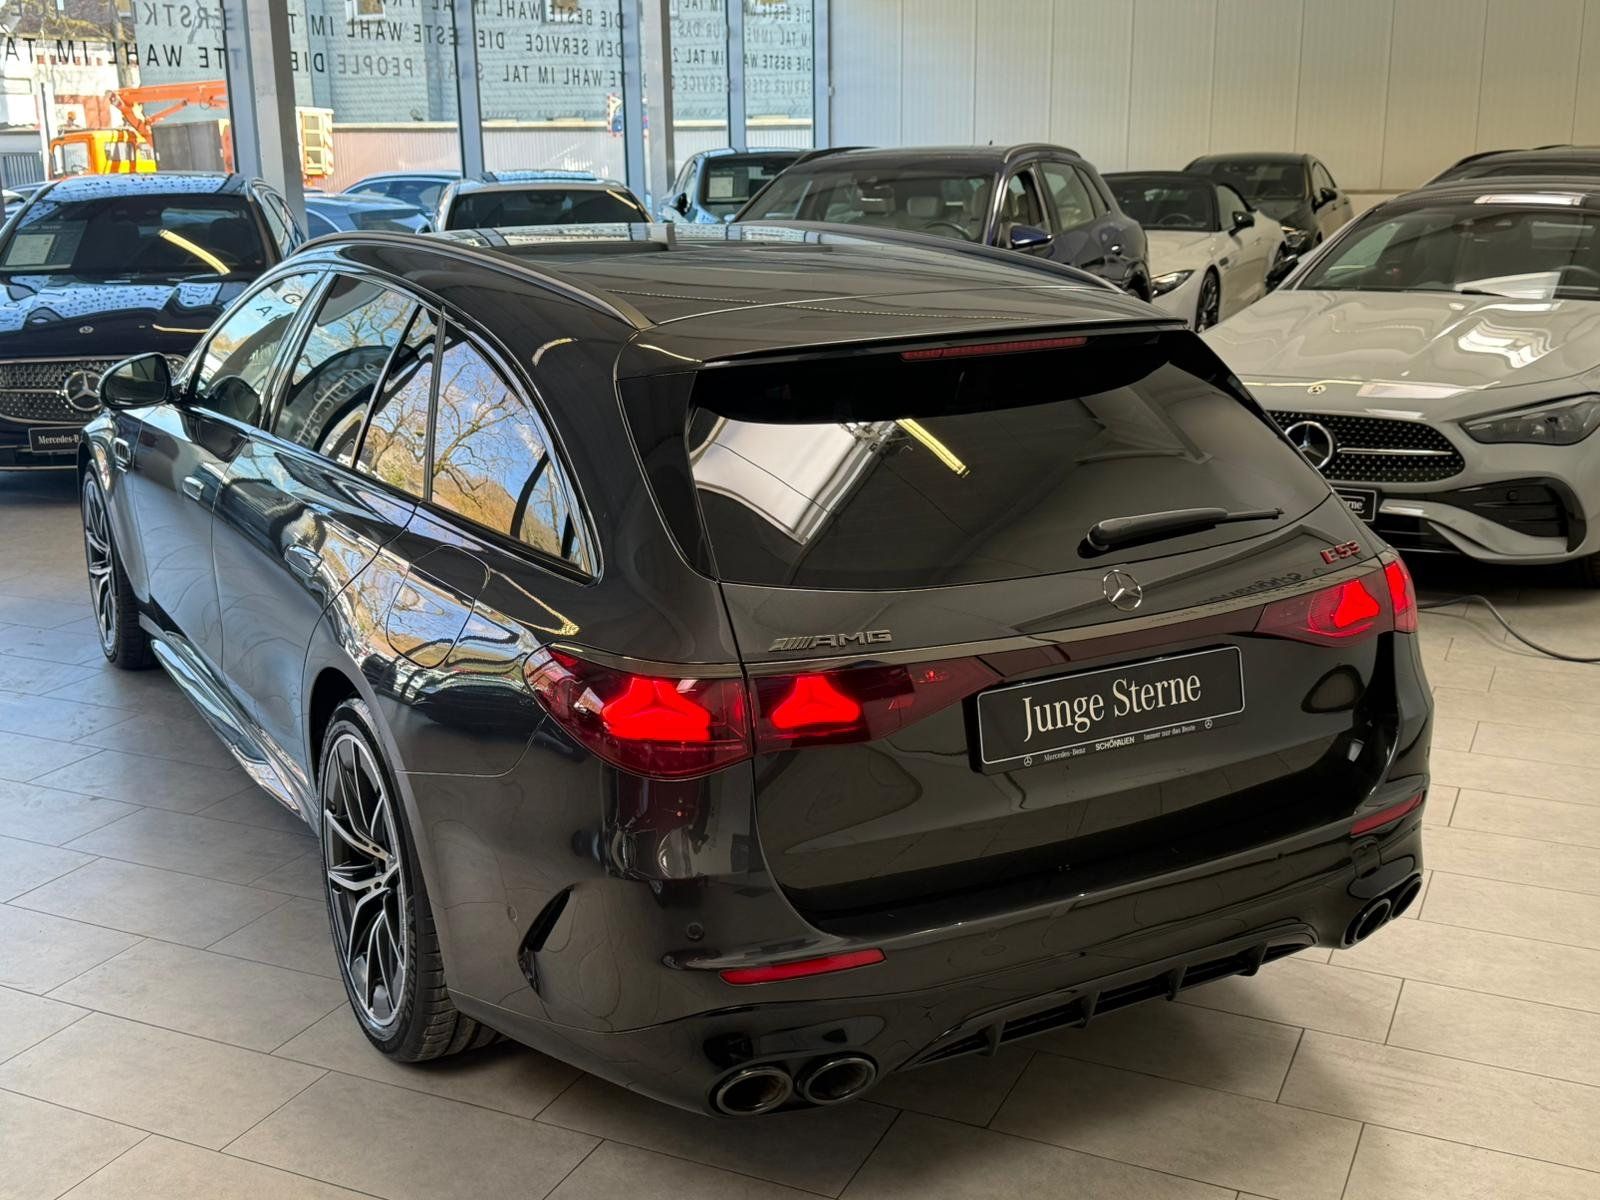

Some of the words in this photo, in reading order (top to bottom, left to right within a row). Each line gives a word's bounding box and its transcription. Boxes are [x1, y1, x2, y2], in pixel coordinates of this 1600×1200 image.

[38, 434, 79, 444] Mercedes-B
[1022, 692, 1105, 742] Junge
[1111, 674, 1202, 718] Sterne
[1044, 749, 1086, 762] Mercedes-Benz
